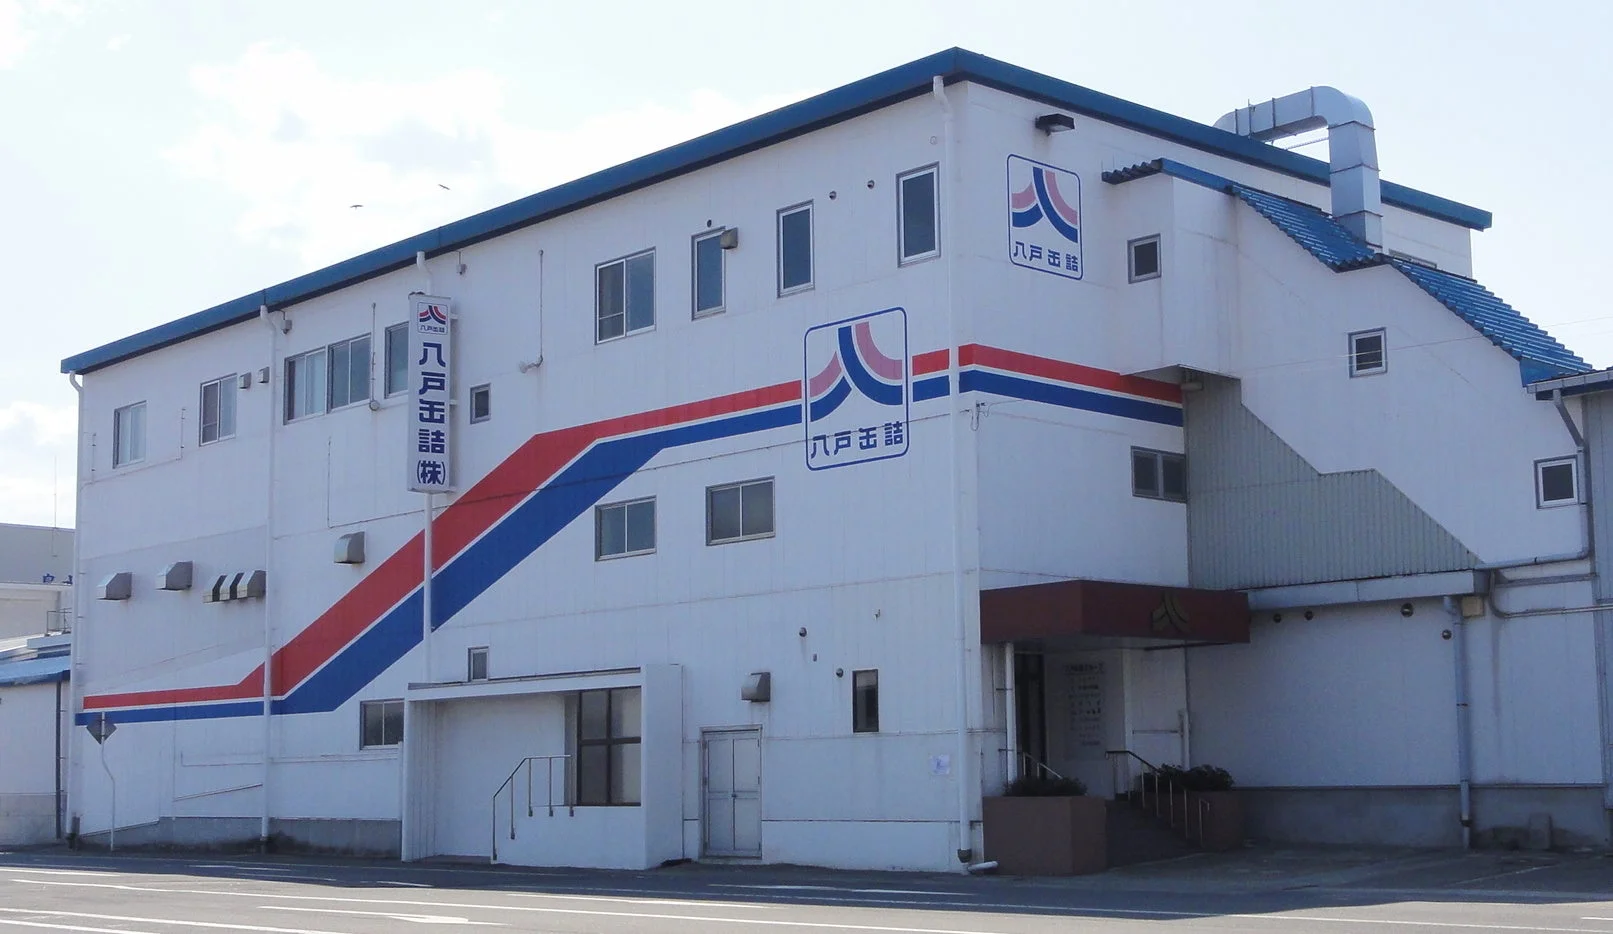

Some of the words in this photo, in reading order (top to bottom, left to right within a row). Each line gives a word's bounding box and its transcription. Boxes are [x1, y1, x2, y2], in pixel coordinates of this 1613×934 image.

[1013, 241, 1078, 272] 八戸缶詰
[811, 421, 903, 459] 八戸缶詰
